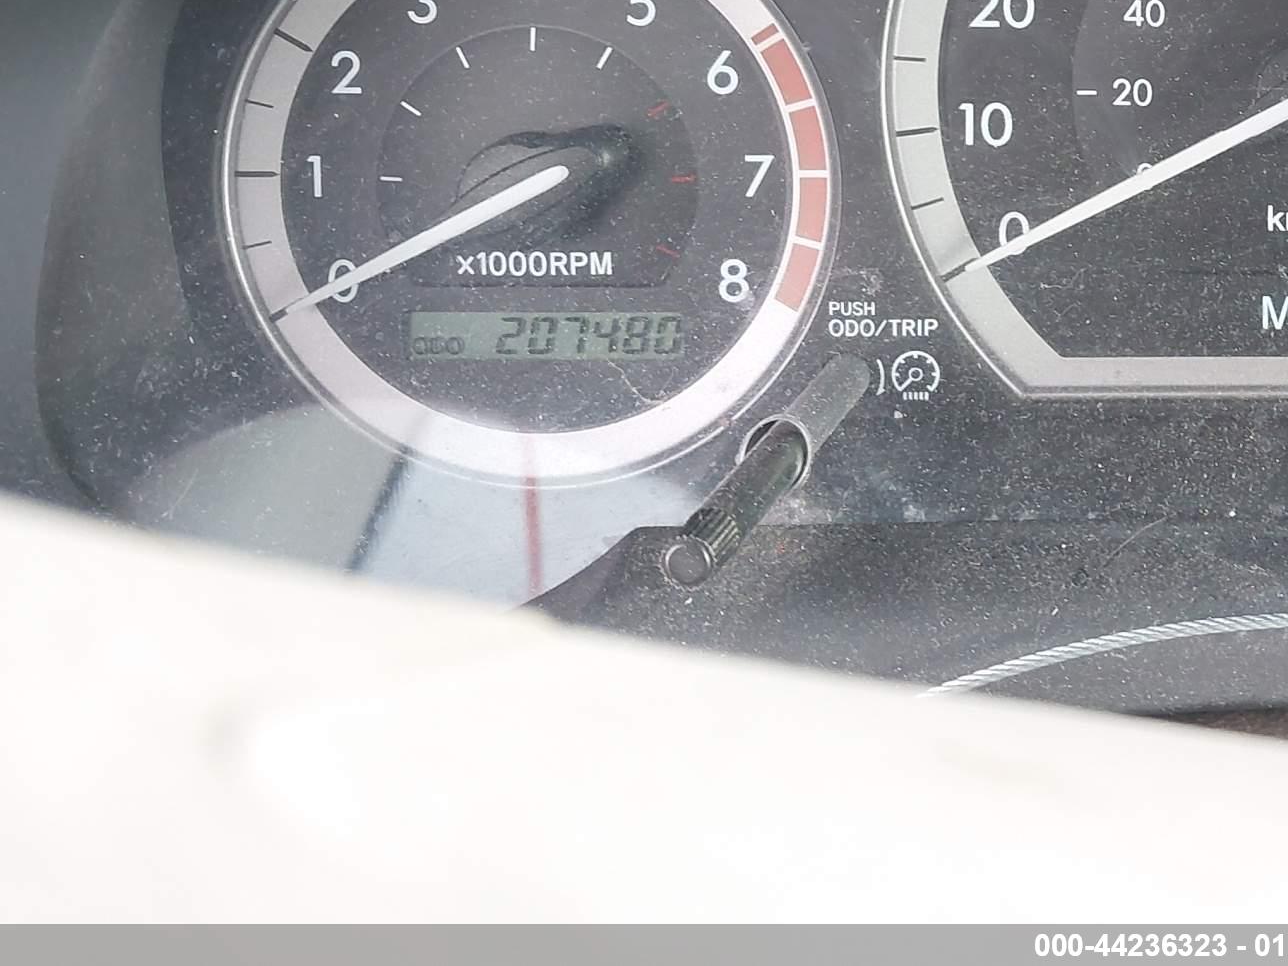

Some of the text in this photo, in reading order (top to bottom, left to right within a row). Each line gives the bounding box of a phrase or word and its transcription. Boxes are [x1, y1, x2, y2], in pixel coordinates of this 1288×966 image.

[331, 50, 363, 95] 2
[707, 50, 739, 95] 6
[1112, 78, 1153, 107] 20
[958, 102, 1013, 147] 10
[305, 156, 323, 197] 1
[743, 154, 775, 197] 7
[999, 211, 1029, 256] 0
[328, 258, 359, 304] 0
[457, 251, 613, 278] x1000RPM
[718, 258, 750, 303] 8
[828, 301, 875, 316] PUSH
[828, 319, 938, 337] ODO/TRIP
[496, 316, 681, 355] 207480
